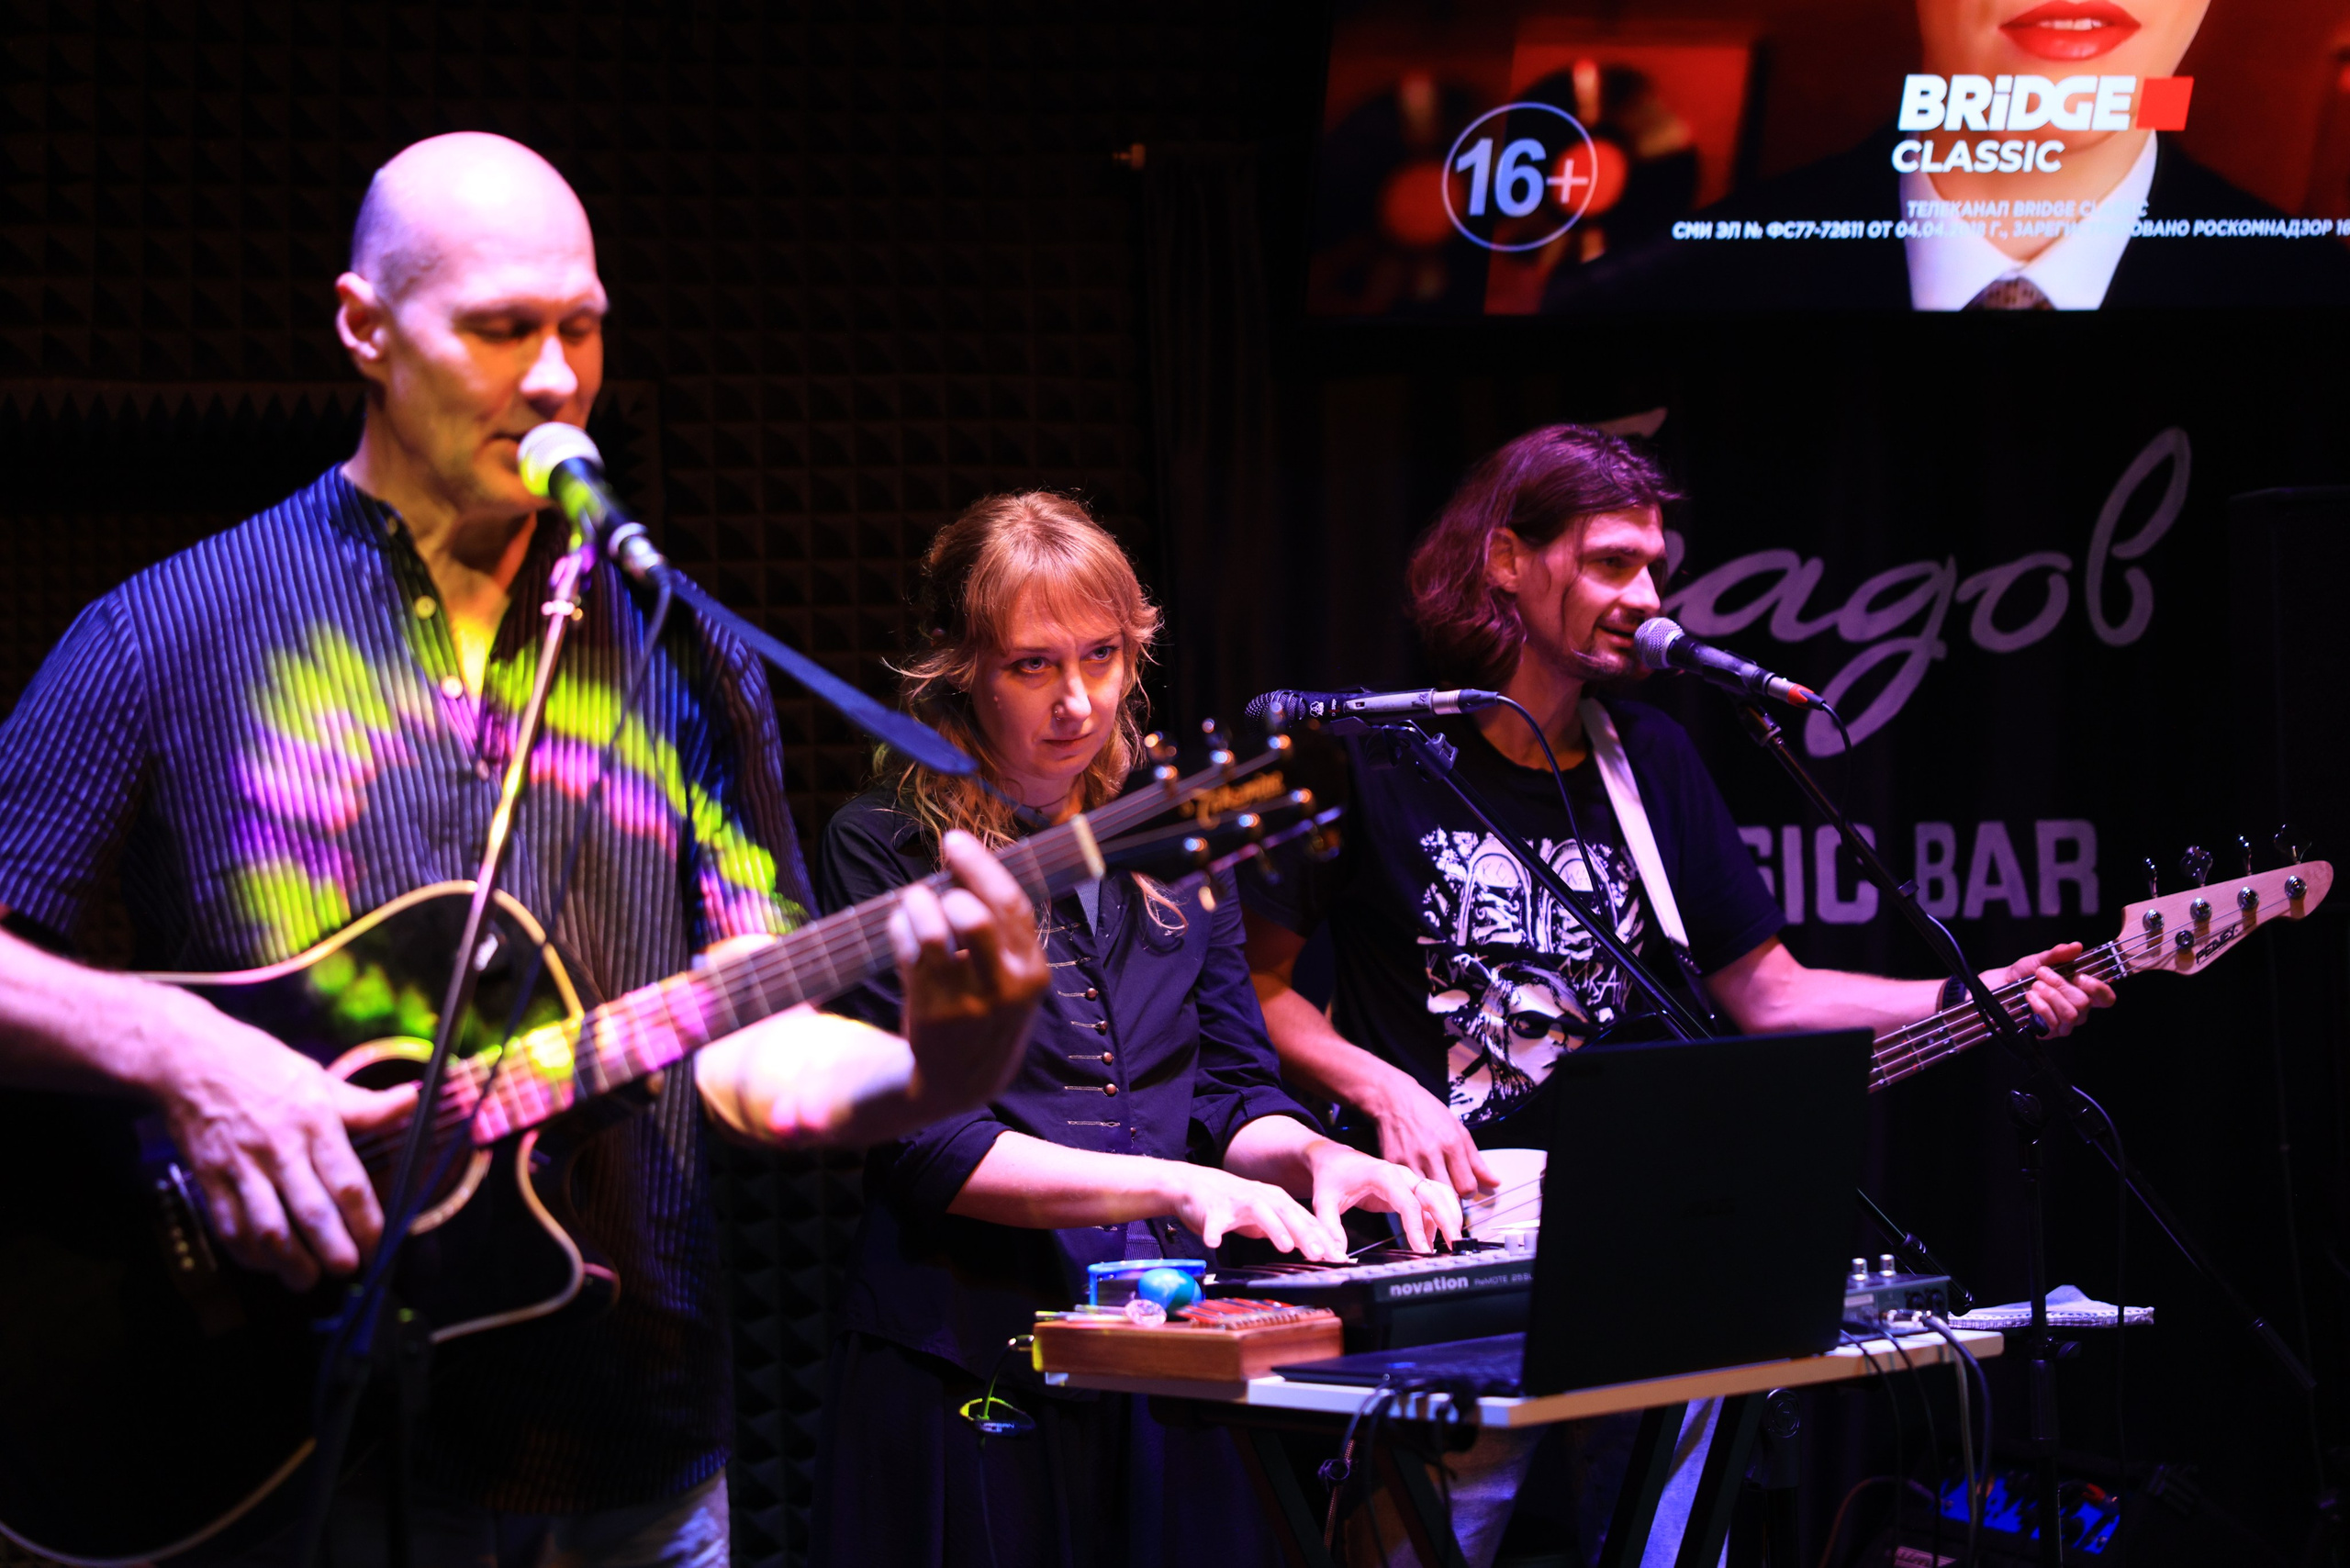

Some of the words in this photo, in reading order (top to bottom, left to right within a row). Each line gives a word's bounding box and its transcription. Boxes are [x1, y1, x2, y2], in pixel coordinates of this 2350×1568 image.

[1891, 139, 2064, 174] CLASSIC
[1455, 138, 1589, 217] 16+
[1908, 200, 2010, 218] ТЕЛЕКАНАЛ
[2013, 200, 2075, 218] BRIDGE
[1672, 220, 1713, 240] СМИ
[1765, 220, 1865, 240] ФС77-72611
[1866, 220, 1894, 239] ОТ
[2193, 218, 2333, 240] РОСКОМНАДЗОР
[1915, 819, 2100, 920] BAR
[1389, 1275, 1469, 1298] novation
